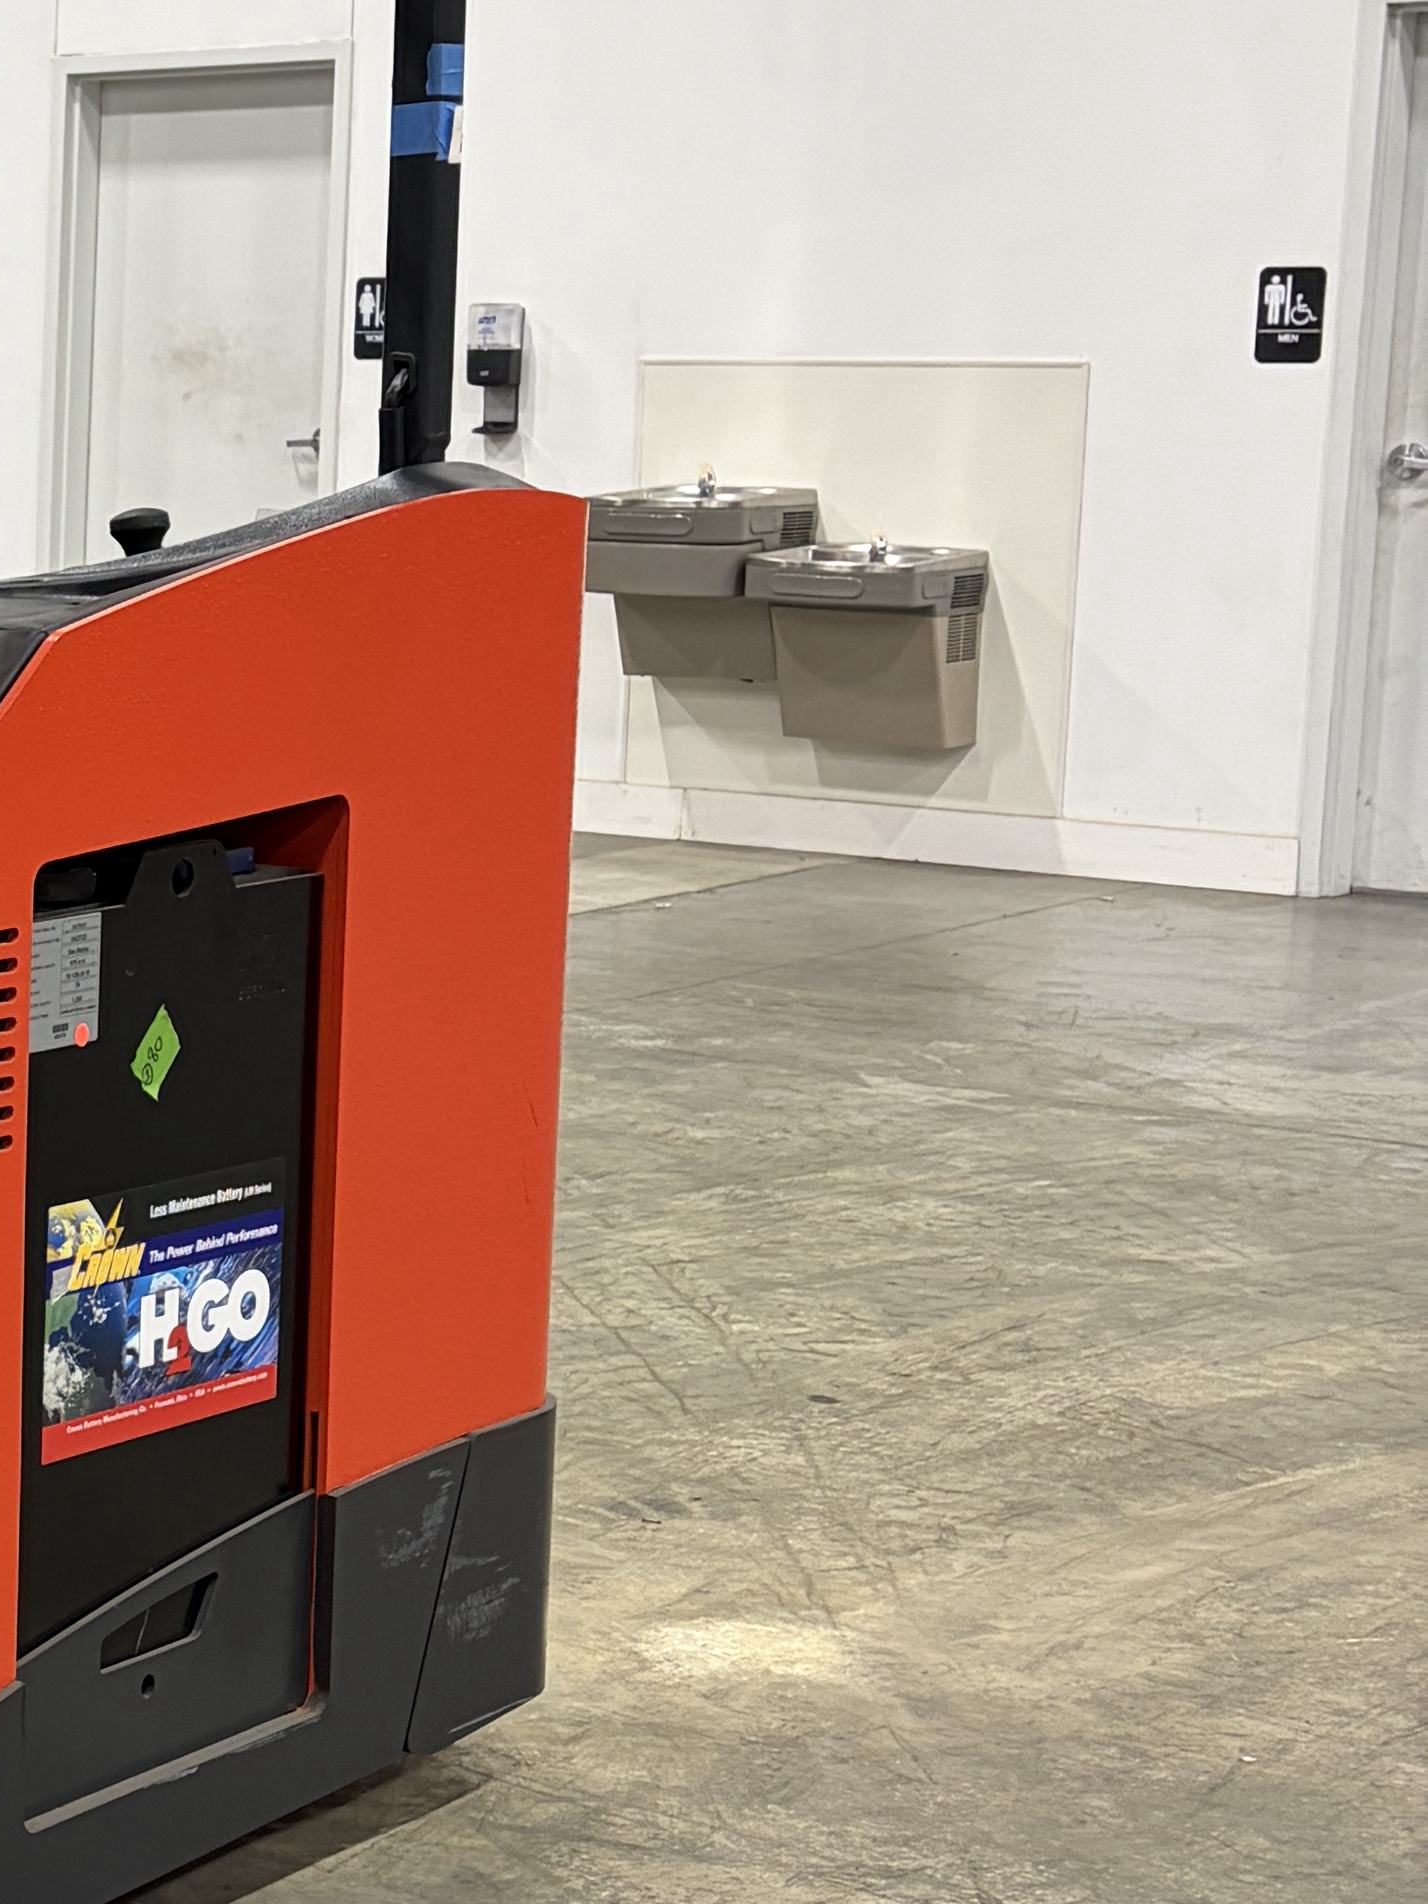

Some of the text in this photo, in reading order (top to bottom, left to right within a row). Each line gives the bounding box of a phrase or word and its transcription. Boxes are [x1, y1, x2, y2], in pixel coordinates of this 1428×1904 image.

[365, 334, 384, 343] WOM
[150, 1204, 167, 1219] Less
[168, 1193, 216, 1214] Maintenance
[217, 1187, 243, 1204] Battery
[149, 1224, 279, 1264] The Power Behind Performance
[68, 1243, 145, 1290] CROWN
[138, 1269, 270, 1376] H2GO
